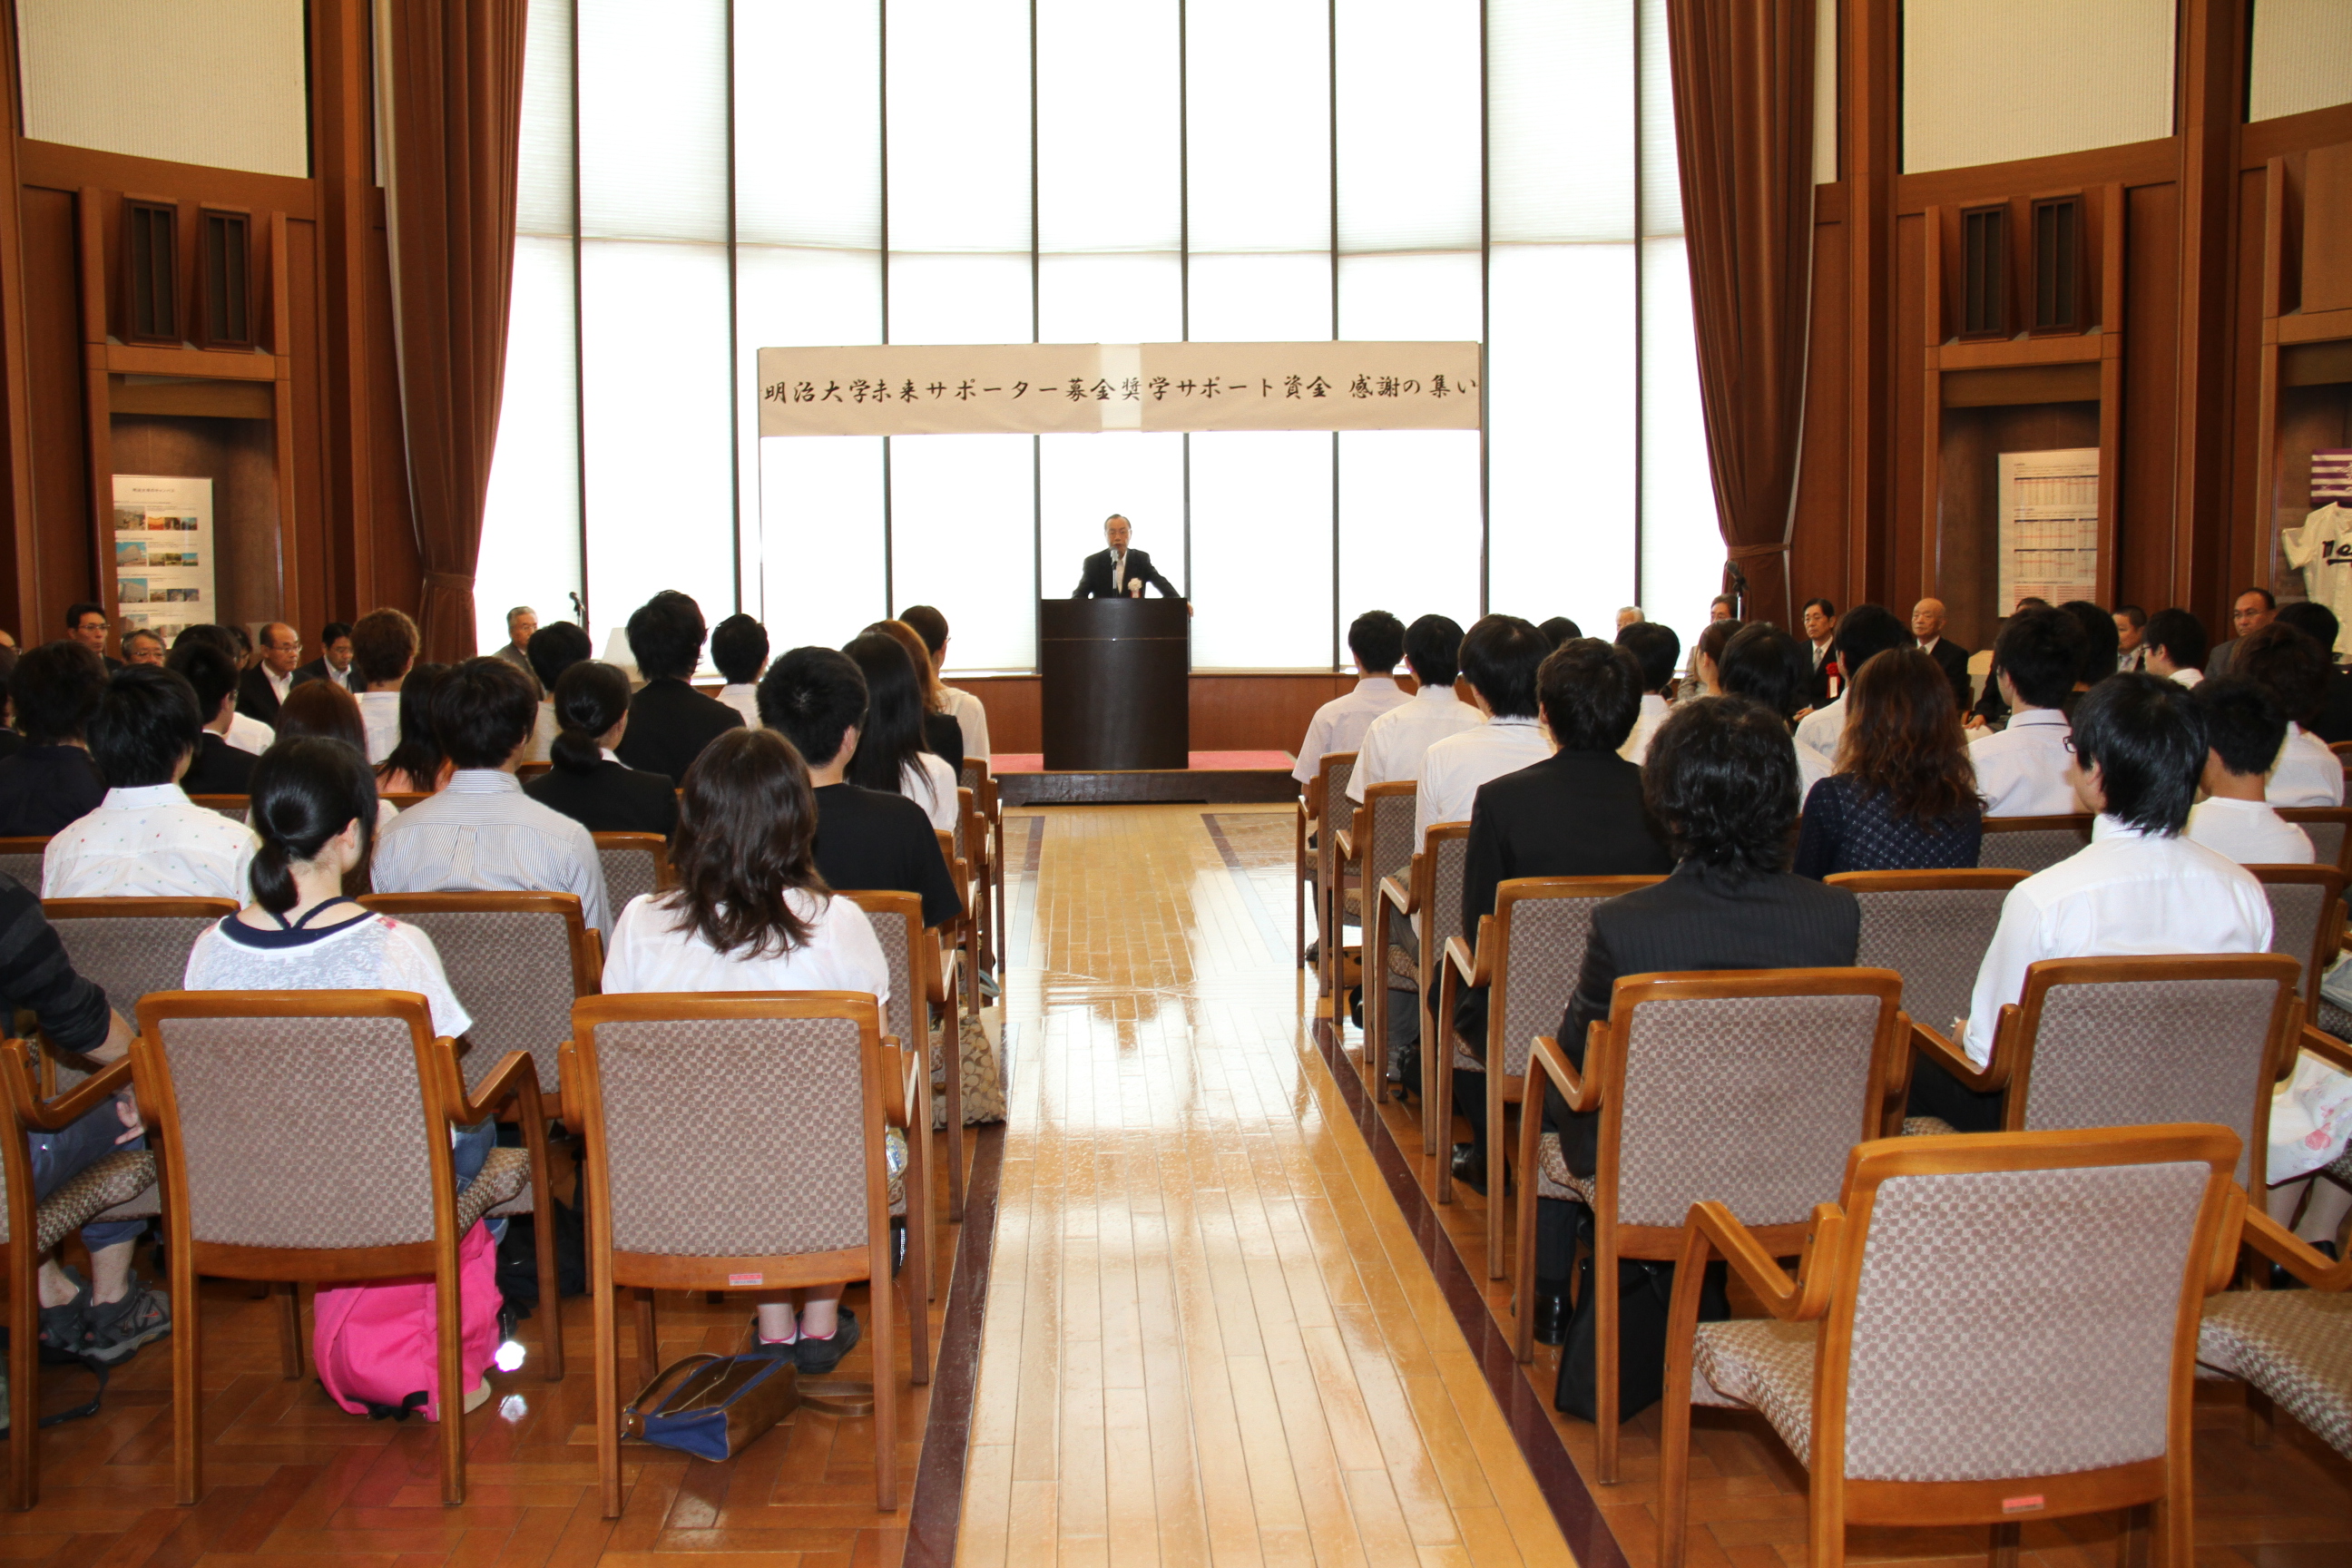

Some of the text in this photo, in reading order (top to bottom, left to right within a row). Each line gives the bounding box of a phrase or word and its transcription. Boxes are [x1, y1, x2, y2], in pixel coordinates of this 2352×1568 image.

[764, 374, 1479, 403] 明治大学未来サポーター募金奨学サポート資金 感謝の集い
